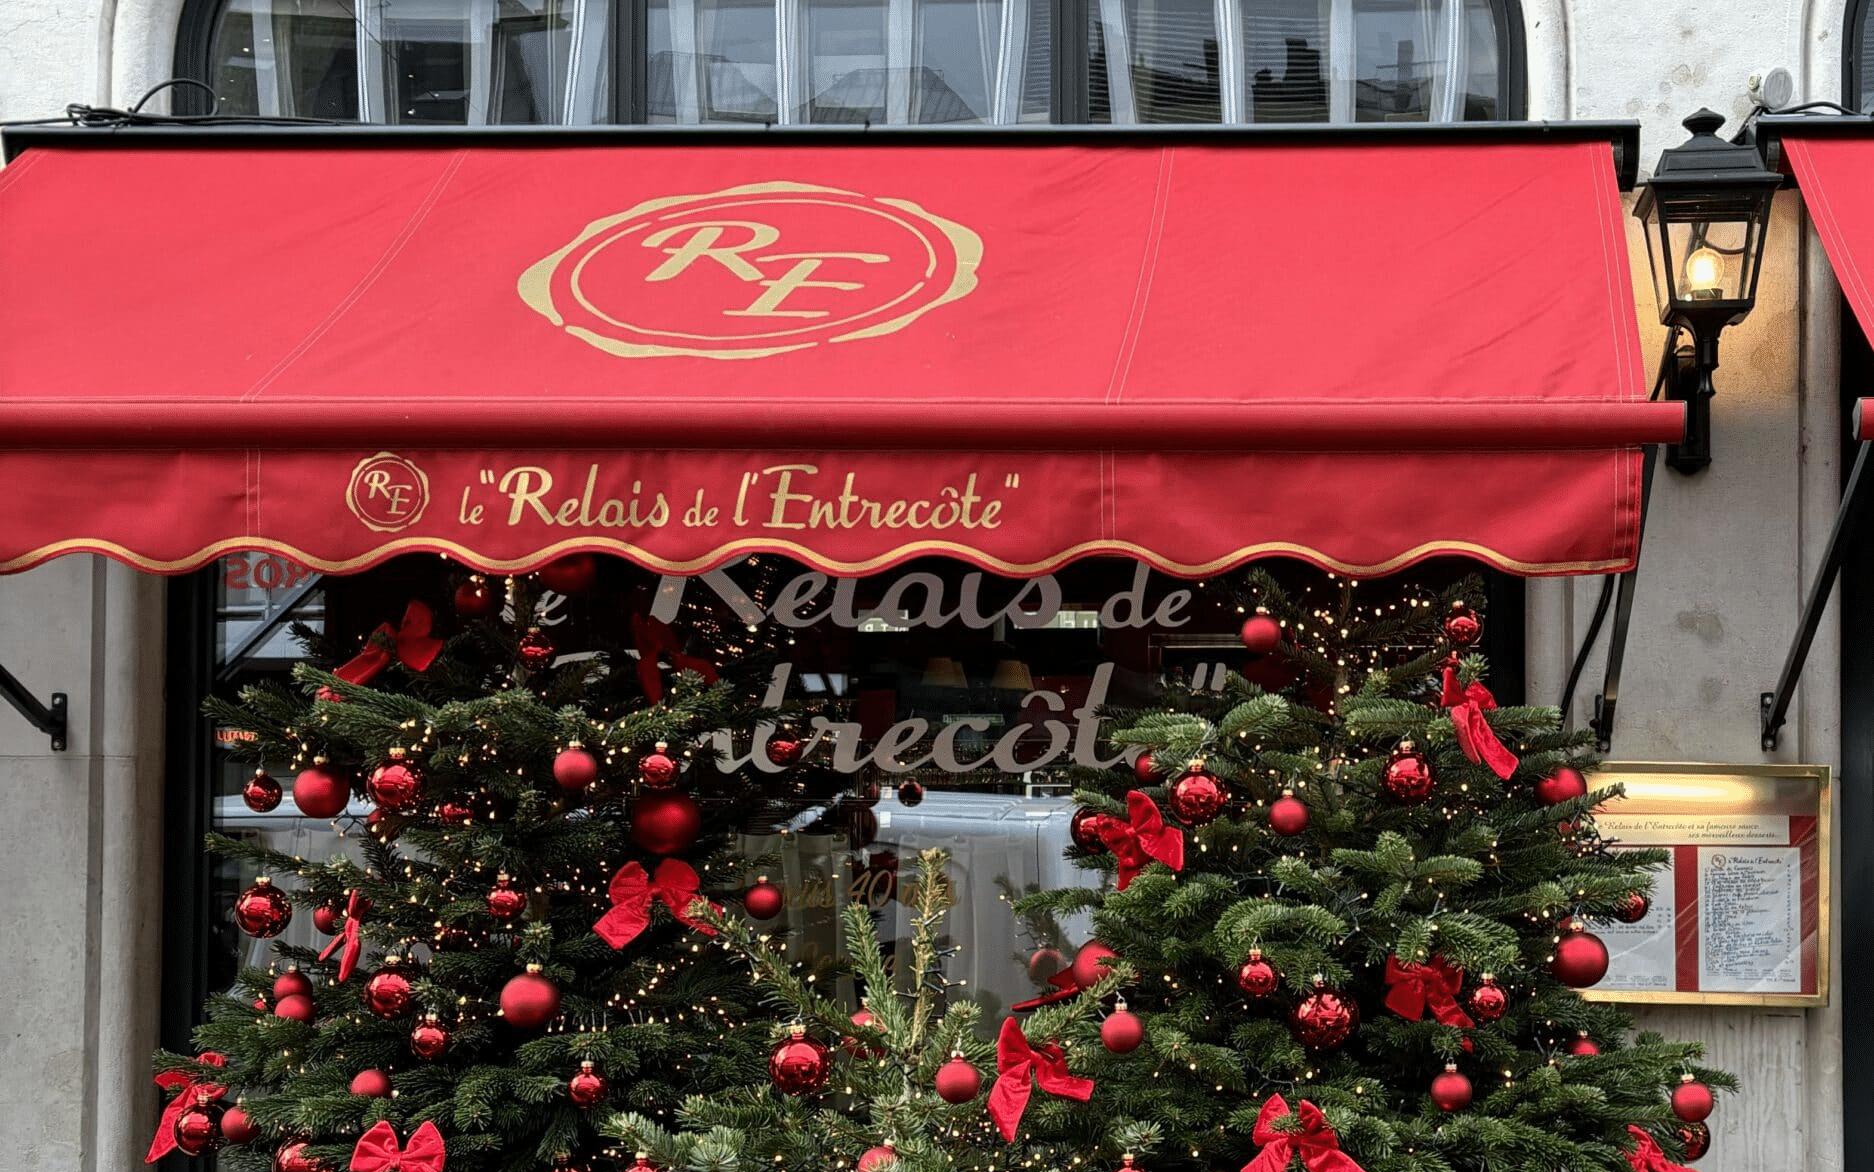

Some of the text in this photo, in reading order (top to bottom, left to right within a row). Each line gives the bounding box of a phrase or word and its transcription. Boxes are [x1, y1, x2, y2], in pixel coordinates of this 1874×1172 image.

[641, 220, 890, 317] RE
[363, 470, 413, 514] RE
[459, 486, 484, 525] le
[682, 488, 719, 527] de
[1099, 560, 1192, 629] de
[848, 870, 893, 909] 40
